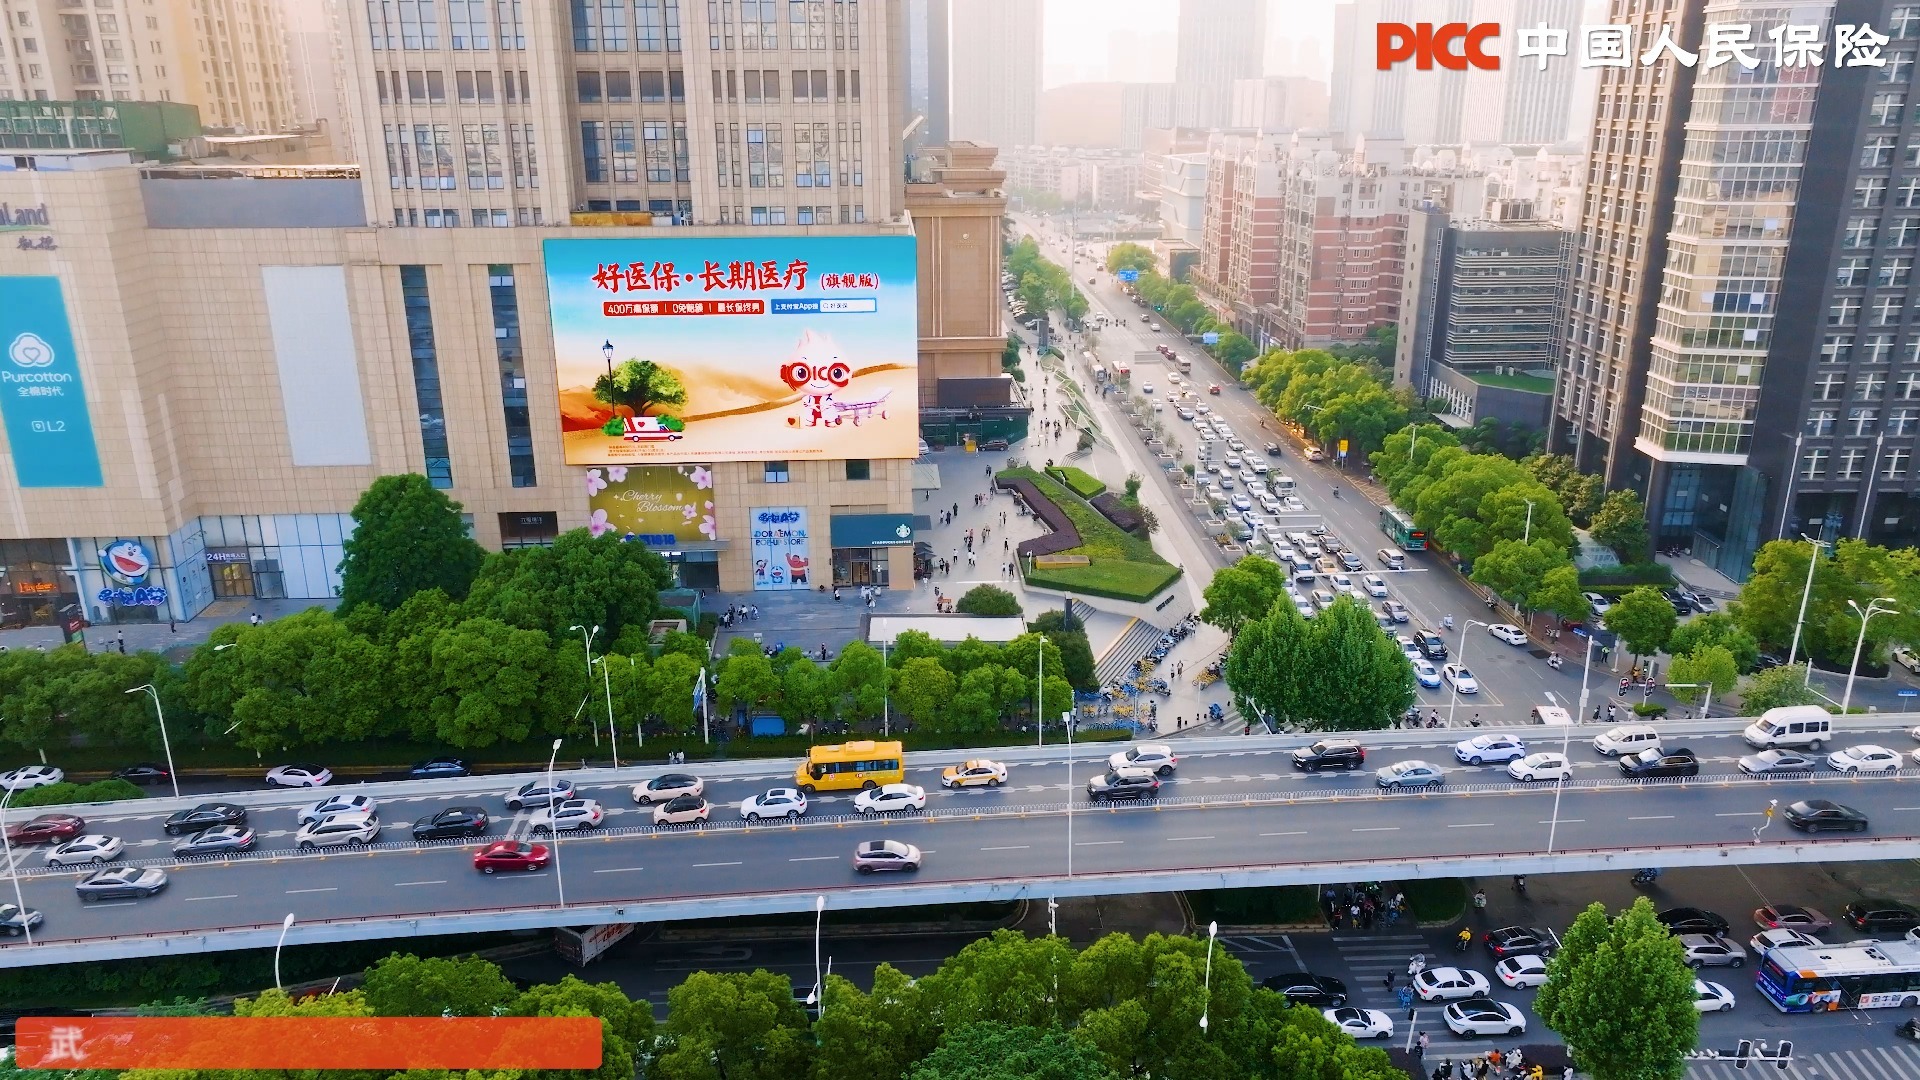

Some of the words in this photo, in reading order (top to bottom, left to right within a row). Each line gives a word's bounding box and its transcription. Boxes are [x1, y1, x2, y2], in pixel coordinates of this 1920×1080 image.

[592, 258, 809, 293] 好医保·长期医疗
[2, 370, 72, 383] Purcotton
[18, 386, 64, 397] 全棉时代
[47, 421, 66, 432] L2
[622, 489, 662, 504] Cherry
[637, 501, 684, 514] Blossom
[754, 530, 806, 538] DORAEMON
